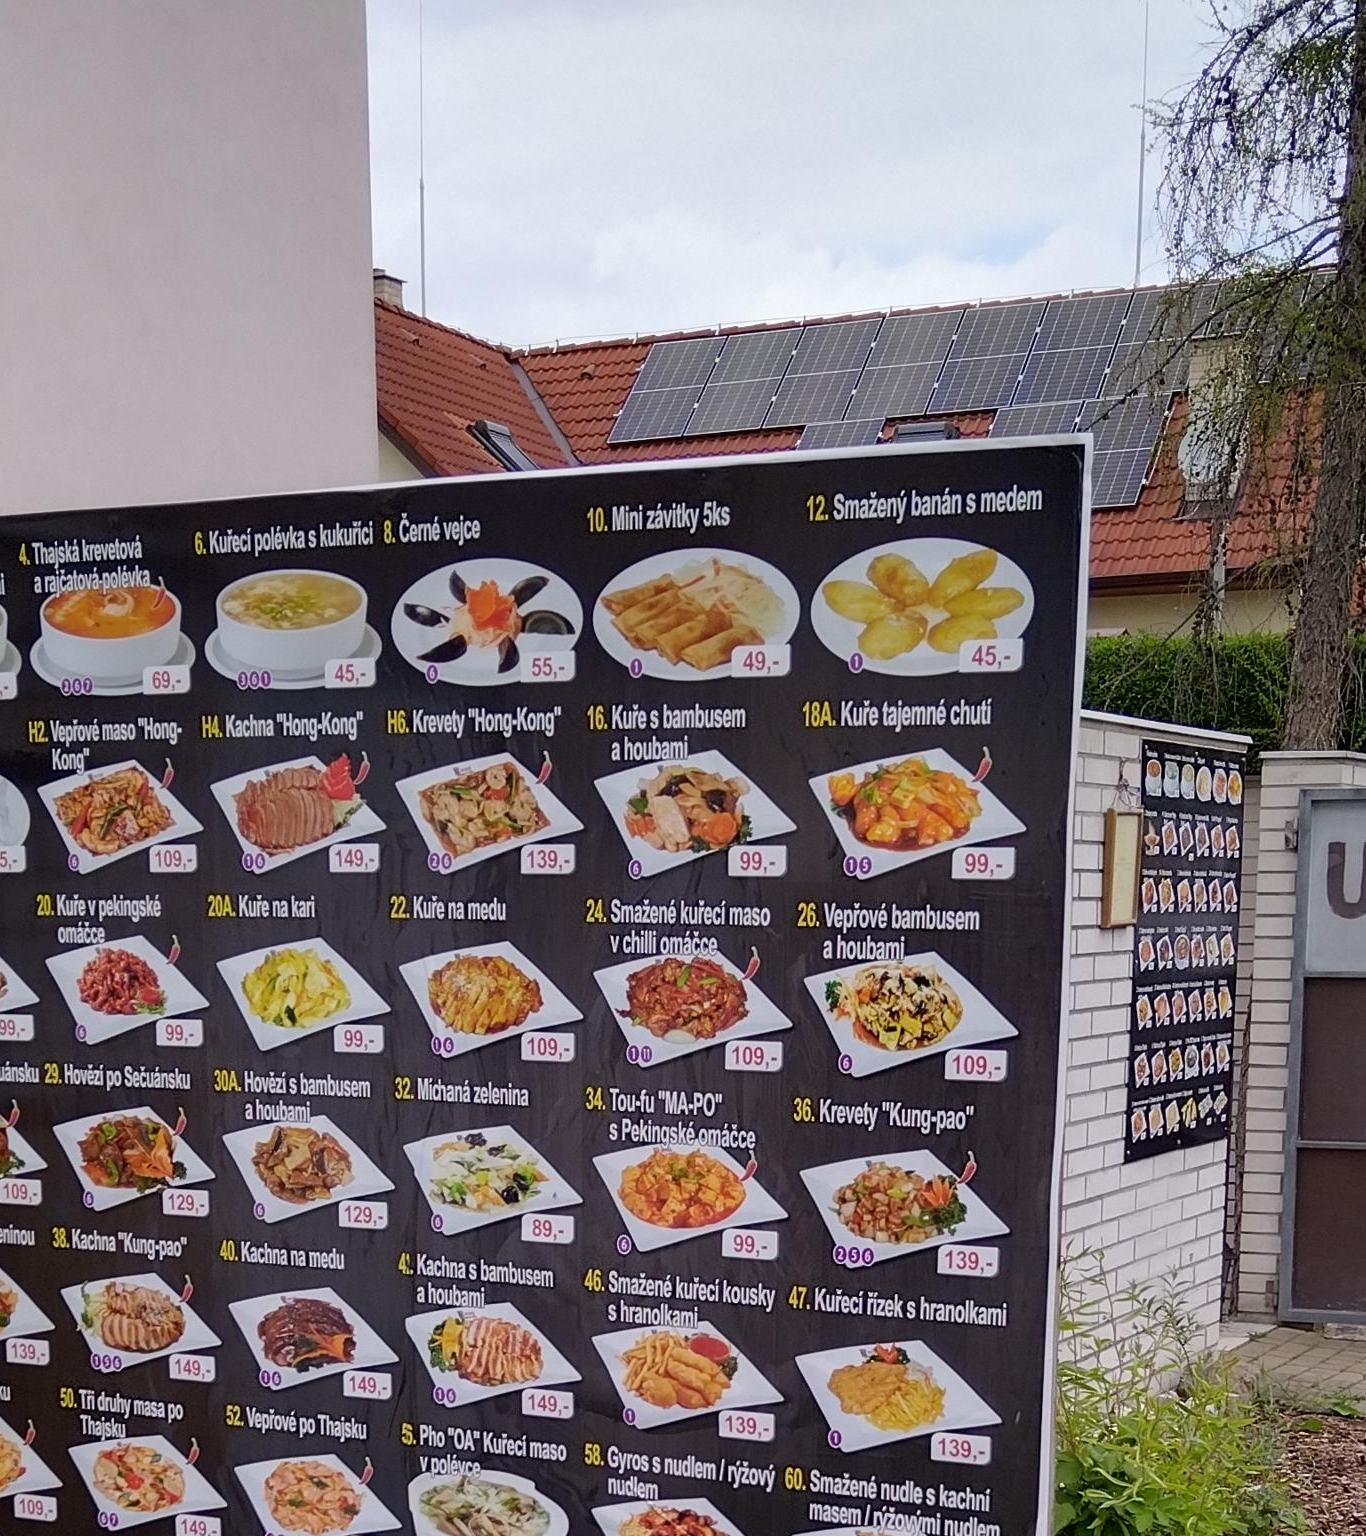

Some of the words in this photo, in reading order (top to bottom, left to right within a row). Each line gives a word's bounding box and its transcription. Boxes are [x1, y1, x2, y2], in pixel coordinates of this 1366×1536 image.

[587, 508, 607, 532] 10.
[612, 505, 642, 530] Mini
[647, 503, 699, 534] závitky
[704, 501, 730, 527] 5ks
[807, 495, 828, 522] 12.
[833, 490, 906, 524] Smažený
[912, 487, 961, 518] banán
[966, 494, 976, 515] s
[981, 487, 1042, 512] medem
[384, 520, 395, 543] 8.
[399, 513, 439, 543] Černé
[443, 516, 480, 548] vejce
[202, 715, 223, 738] H4.
[225, 714, 273, 737] Kachna
[277, 711, 363, 741] "Hong-Kong"
[388, 710, 409, 733] H6.
[413, 708, 464, 738] Krevety
[468, 706, 561, 737] "Hong-Kong"
[587, 706, 607, 730] 16.
[612, 705, 646, 729] Kuře
[650, 710, 660, 728] s
[663, 704, 746, 728] bambusem
[803, 702, 836, 727] 18A.
[841, 701, 878, 726] Kuře
[883, 700, 946, 730] tajemné
[950, 699, 991, 725] chutí
[208, 895, 236, 917] 20A.
[239, 895, 269, 917] Kuře
[272, 900, 288, 918] na
[291, 896, 315, 918] kari
[390, 897, 409, 919] 22.
[413, 896, 445, 919] Kuře
[448, 902, 465, 919] na
[468, 898, 506, 921] medu
[587, 899, 606, 923] 24.
[611, 899, 677, 925] Smažené
[680, 900, 725, 927] kuřecí
[730, 907, 770, 927] maso
[798, 902, 820, 927] 26.
[824, 903, 887, 933] Vepřové
[892, 904, 979, 931] bambusem
[611, 936, 619, 953] v
[623, 930, 656, 954] chilli
[660, 932, 717, 956] omáčce
[215, 1070, 240, 1092] 30A.
[244, 1070, 286, 1094] Hovězí
[289, 1079, 297, 1094] s
[300, 1073, 370, 1098] bambusem
[395, 1077, 414, 1099] 32.
[474, 1083, 529, 1106] zelenina
[586, 1087, 606, 1111] 34.
[610, 1088, 654, 1113] Tou-fu
[658, 1091, 722, 1116] "MA-PO"
[794, 1097, 814, 1122] 36.
[820, 1100, 877, 1129] Krevety
[882, 1103, 974, 1135] "Kung-pao"
[610, 1123, 618, 1141] s
[622, 1117, 694, 1149] Pekingské
[698, 1124, 755, 1149] omáčce
[220, 1240, 237, 1262] 40.
[241, 1241, 287, 1265] Kachna
[290, 1250, 306, 1267] na
[309, 1247, 344, 1270] medu
[585, 1269, 604, 1292] 46.
[608, 1270, 672, 1297] Smažené
[676, 1276, 719, 1302] kuřecí
[723, 1279, 775, 1308] kousky
[789, 1286, 810, 1310] 47.
[814, 1288, 862, 1315] Kuřecí
[867, 1292, 902, 1318] řízek
[906, 1301, 915, 1319] s
[919, 1297, 1007, 1327] hranolkami
[226, 1405, 243, 1427] 52.
[246, 1408, 296, 1435] Vepřové
[299, 1415, 315, 1436] po
[318, 1415, 367, 1443] Thajsku
[785, 1467, 806, 1491] 60.
[810, 1469, 876, 1500] Smažené
[880, 1477, 922, 1504] nudle
[926, 1488, 936, 1506] s
